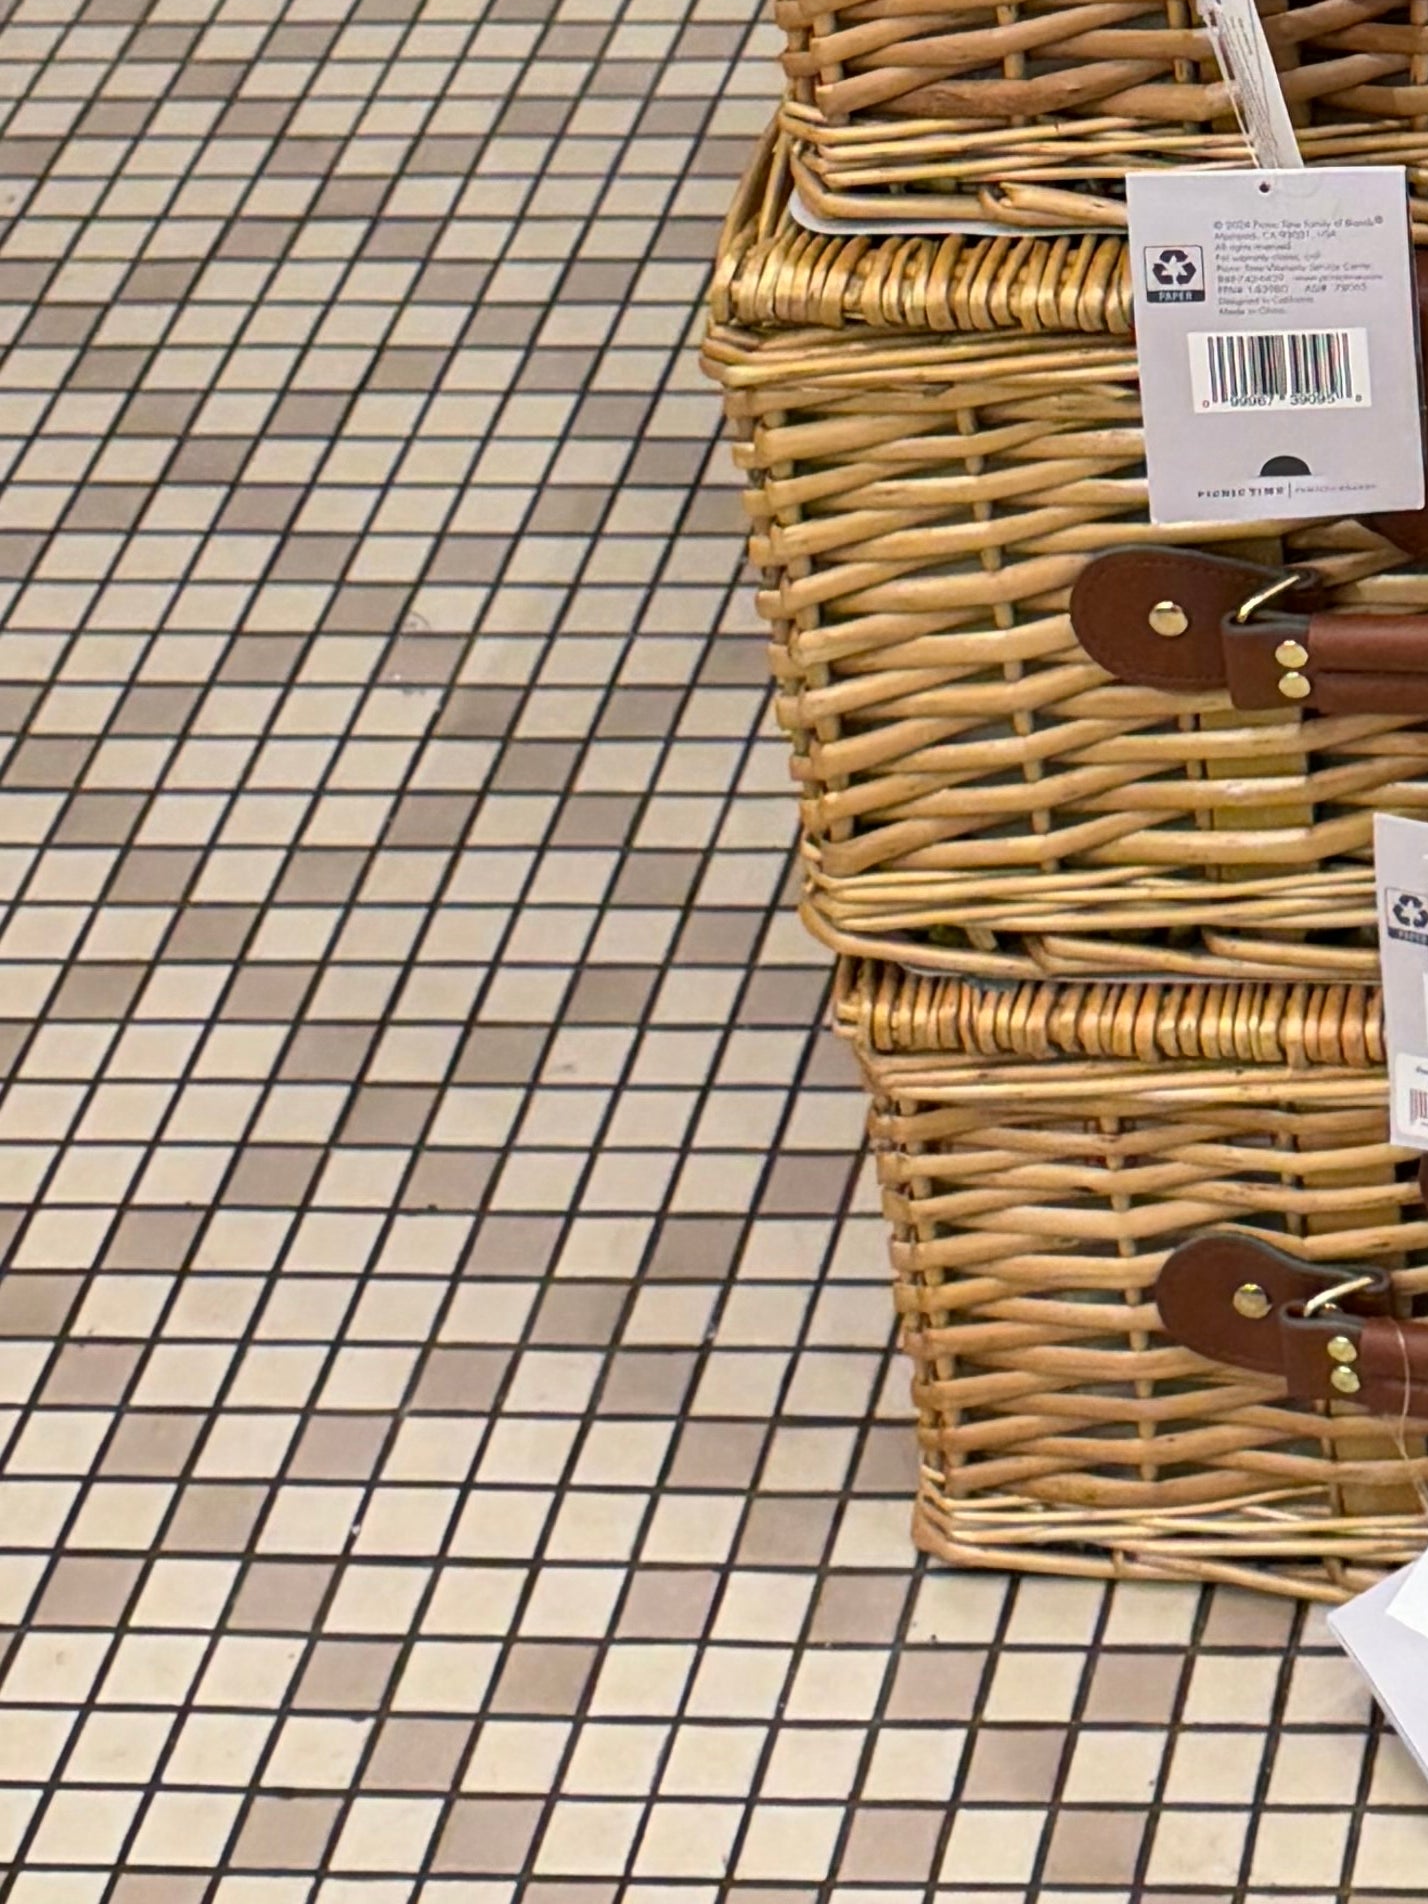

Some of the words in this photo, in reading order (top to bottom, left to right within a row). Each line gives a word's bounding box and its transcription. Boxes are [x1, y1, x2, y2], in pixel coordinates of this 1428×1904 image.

[1157, 292, 1193, 303] PAPER
[1230, 394, 1273, 407] 99967
[1290, 393, 1336, 406] 39095
[1197, 489, 1246, 498] PICNIC
[1249, 486, 1284, 496] TIME
